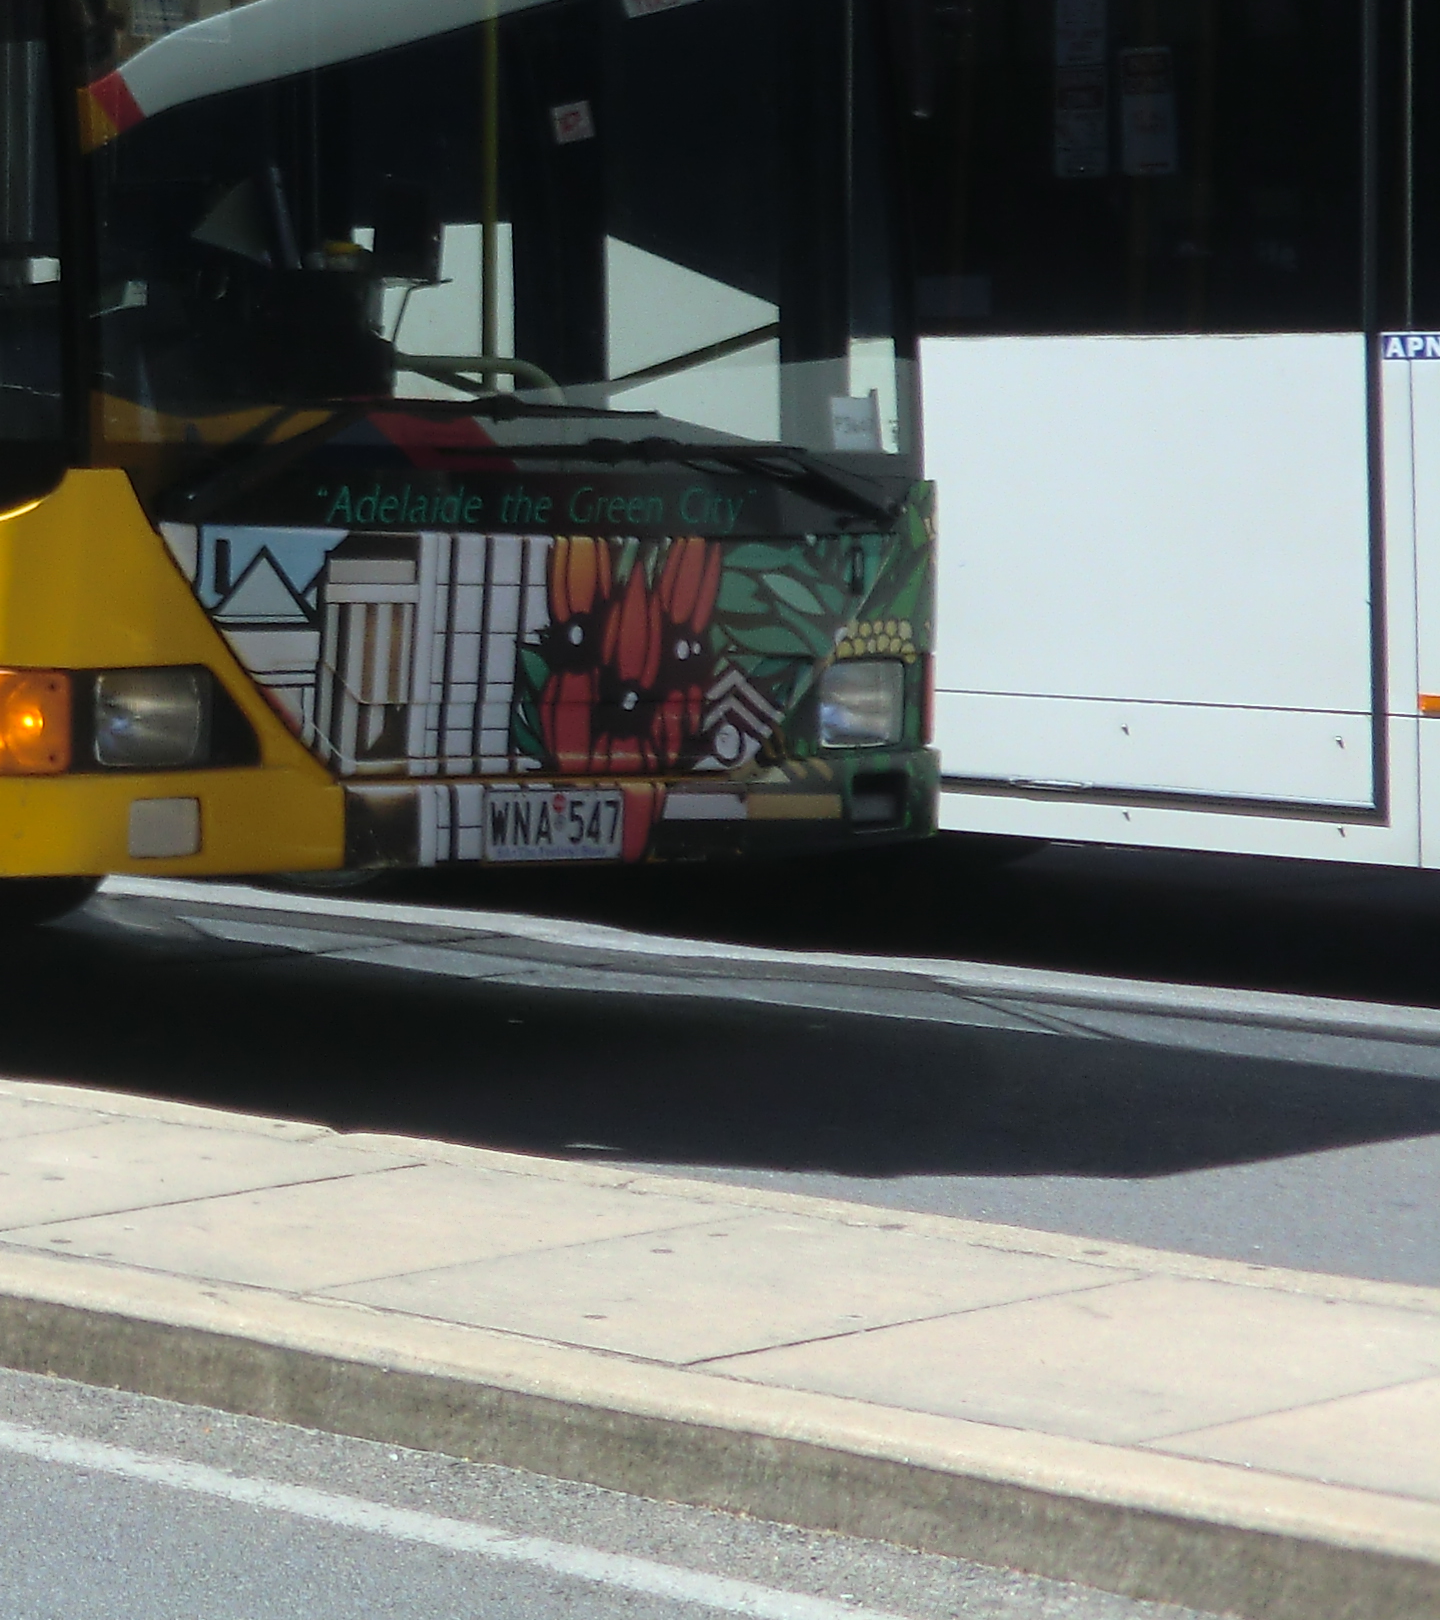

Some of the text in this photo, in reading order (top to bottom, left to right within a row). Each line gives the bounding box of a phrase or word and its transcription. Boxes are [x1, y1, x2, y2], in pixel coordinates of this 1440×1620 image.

[500, 485, 553, 524] the
[568, 486, 664, 525] Green
[491, 799, 619, 845] WNA 547
